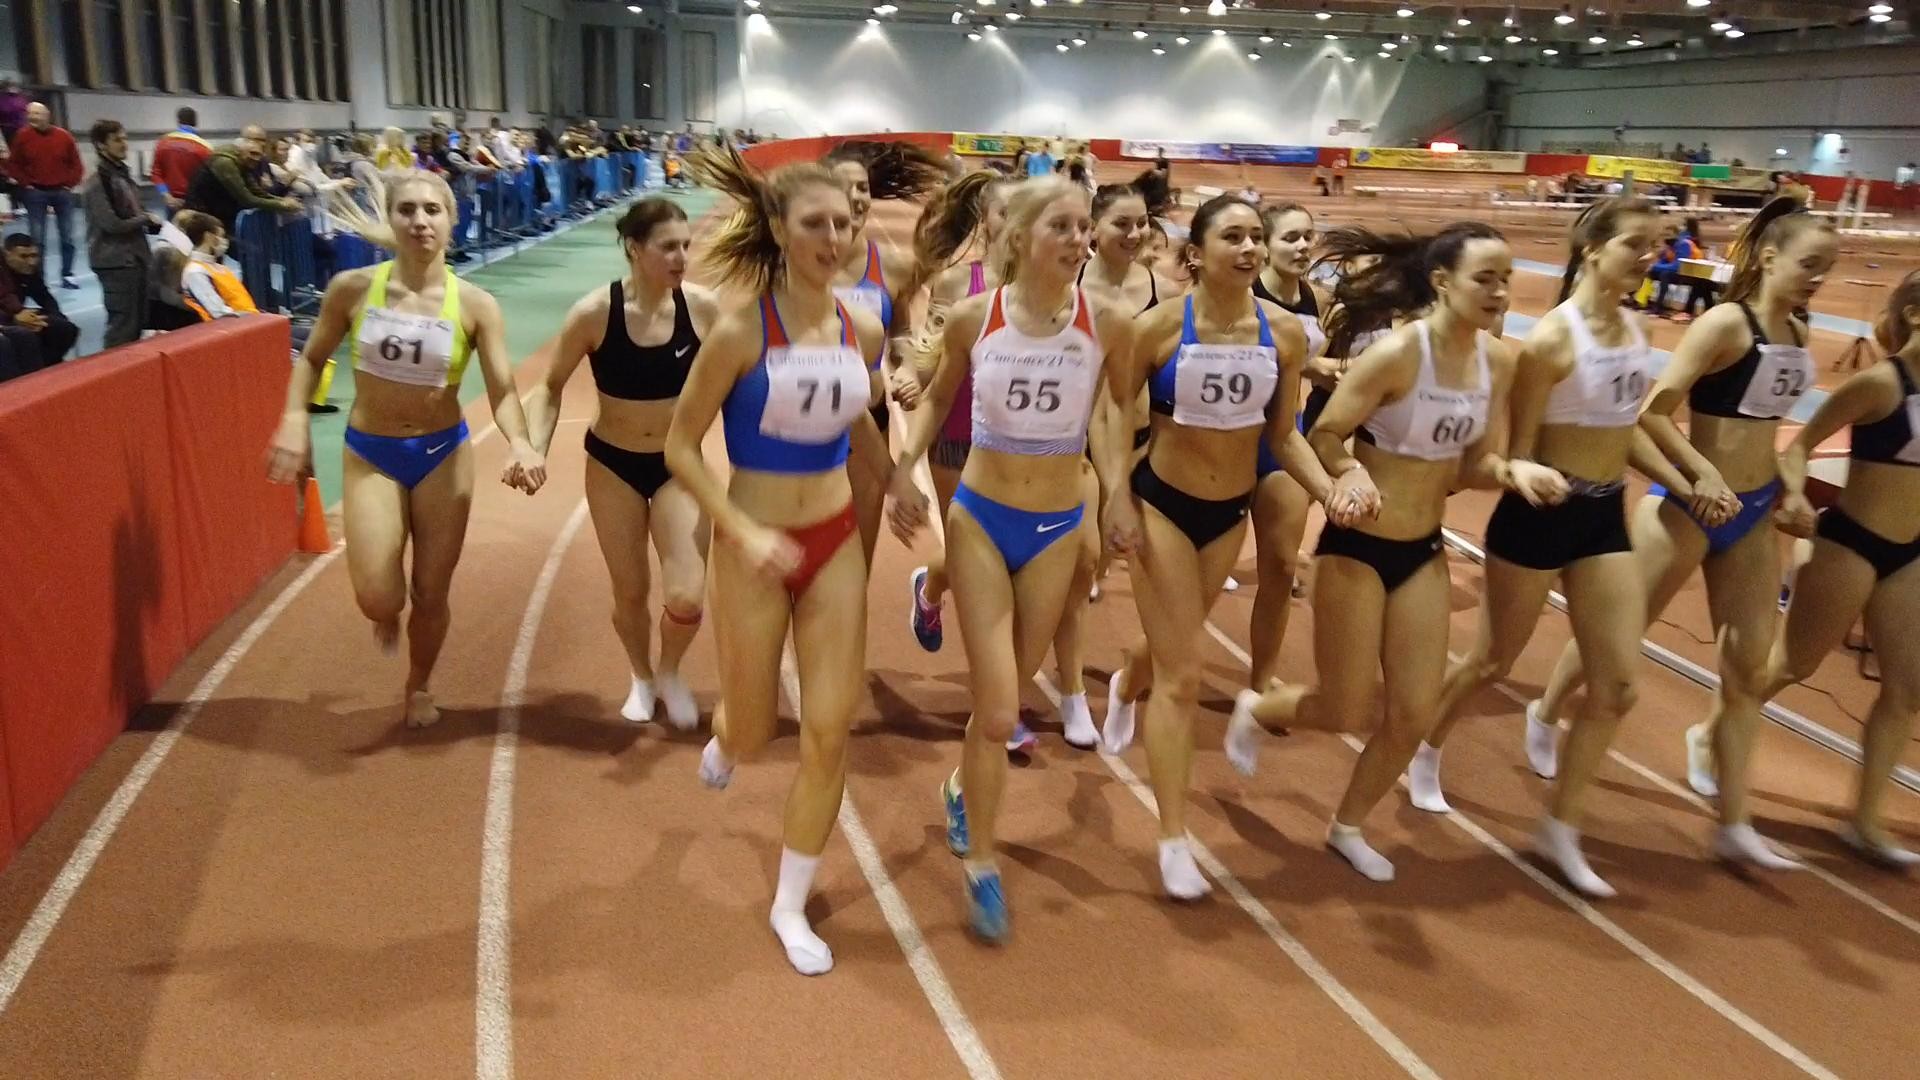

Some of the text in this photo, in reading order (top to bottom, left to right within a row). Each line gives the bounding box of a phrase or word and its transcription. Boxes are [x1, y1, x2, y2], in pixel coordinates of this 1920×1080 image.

[379, 334, 422, 364] 61
[797, 377, 841, 414] 71
[1005, 378, 1061, 413] 55
[1200, 372, 1252, 405] 59
[1770, 367, 1807, 397] 52
[1432, 415, 1475, 443] 60
